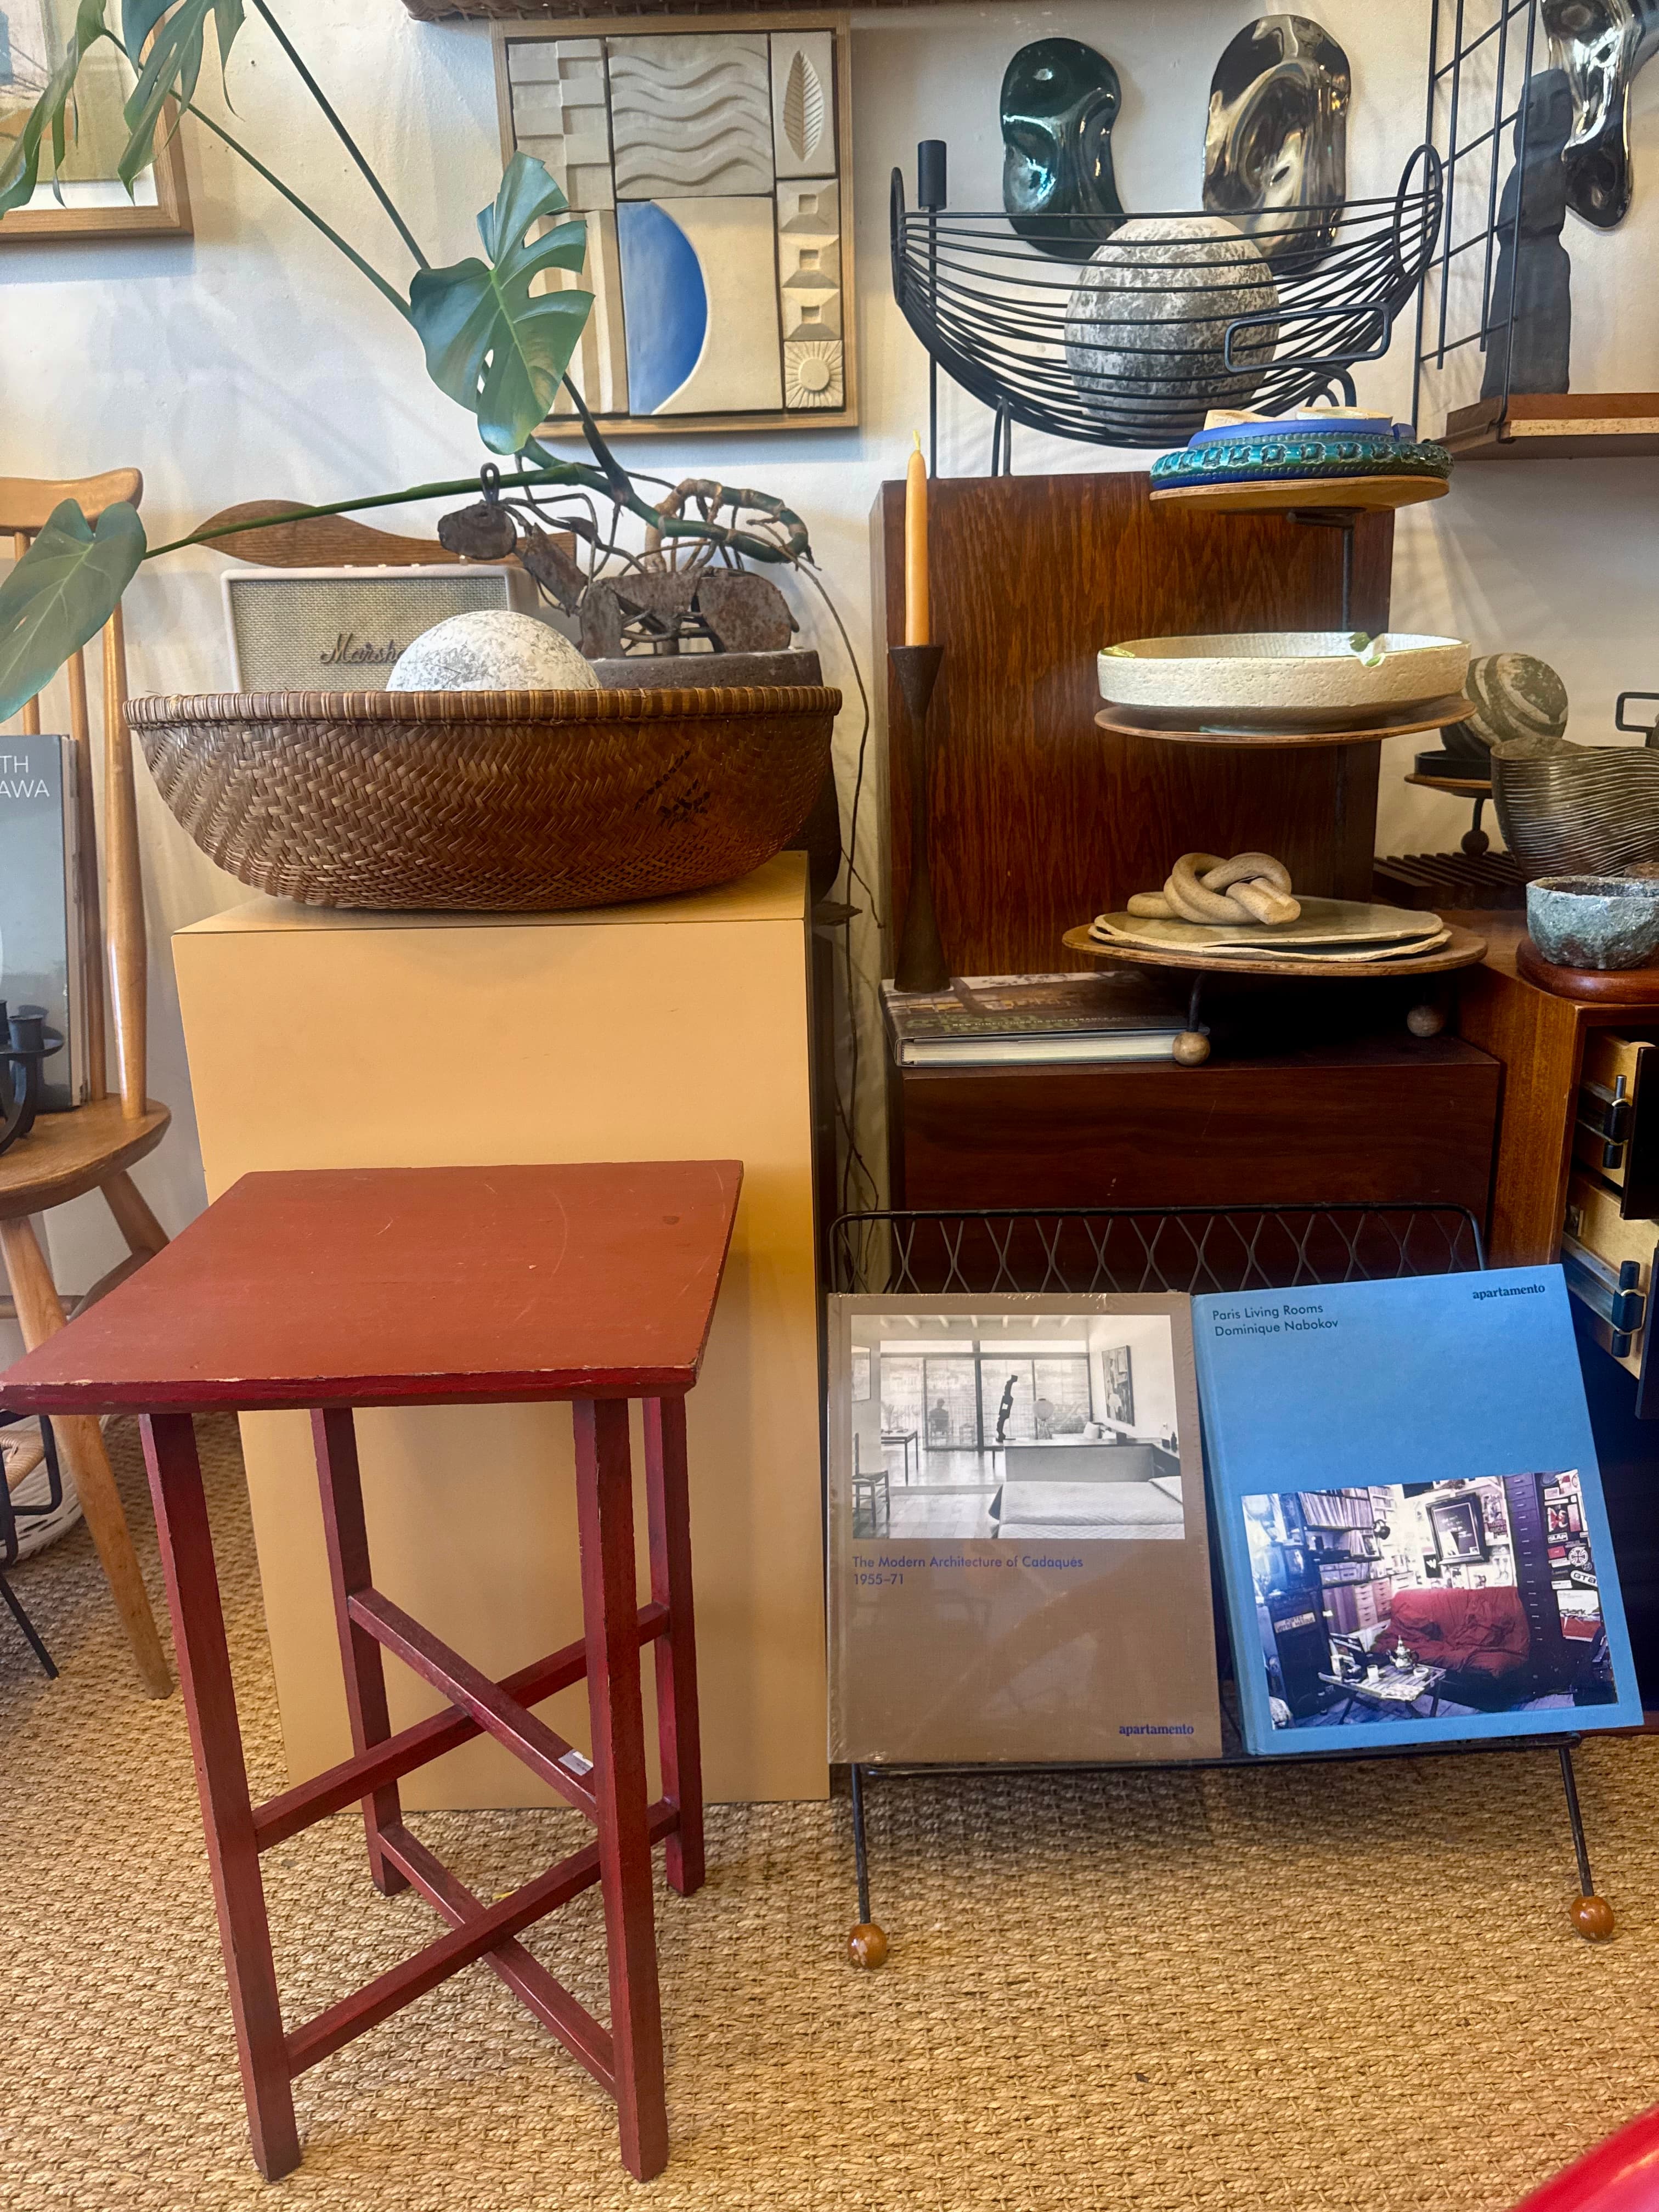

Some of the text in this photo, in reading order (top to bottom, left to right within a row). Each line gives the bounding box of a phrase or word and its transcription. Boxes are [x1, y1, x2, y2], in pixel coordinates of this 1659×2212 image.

[1472, 1284, 1545, 1300] apartamento
[1212, 1305, 1323, 1321] Paris Living Rooms
[1215, 1318, 1339, 1336] Dominique Nabokov
[852, 1555, 1084, 1570] The Modern Architecture of Cadaqués
[1119, 1724, 1194, 1736] apartamento
